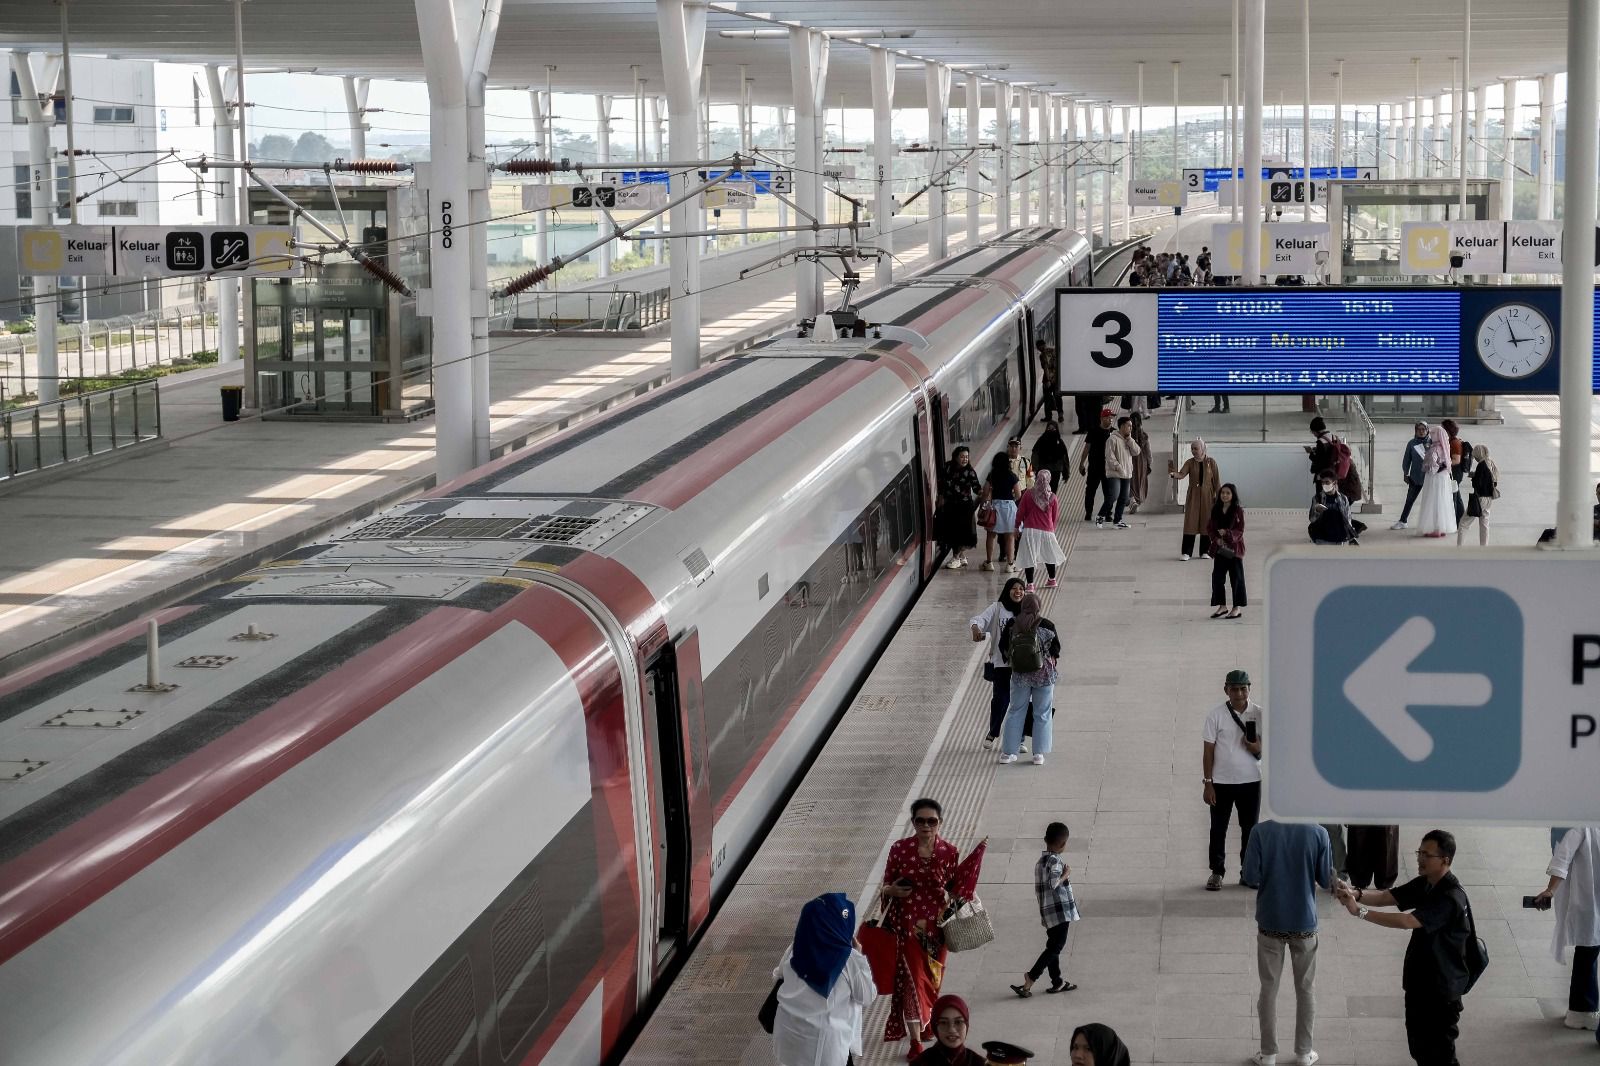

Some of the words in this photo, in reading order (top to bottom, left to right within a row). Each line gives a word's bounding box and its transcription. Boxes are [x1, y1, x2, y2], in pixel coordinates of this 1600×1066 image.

[775, 175, 785, 189] 2
[1188, 174, 1199, 187] 3
[67, 240, 108, 251] Keluar
[120, 240, 160, 251] Keluar
[1275, 238, 1318, 249] Keluar
[1455, 236, 1499, 247] Keluar
[1511, 236, 1556, 247] Keluar
[145, 255, 160, 263] Exit
[1275, 253, 1292, 262] Exit
[1538, 251, 1555, 259] Exit
[1508, 308, 1519, 318] 12
[1090, 310, 1134, 369] 3
[1484, 338, 1491, 347] 9
[1539, 335, 1545, 345] 3
[1511, 365, 1518, 374] 6
